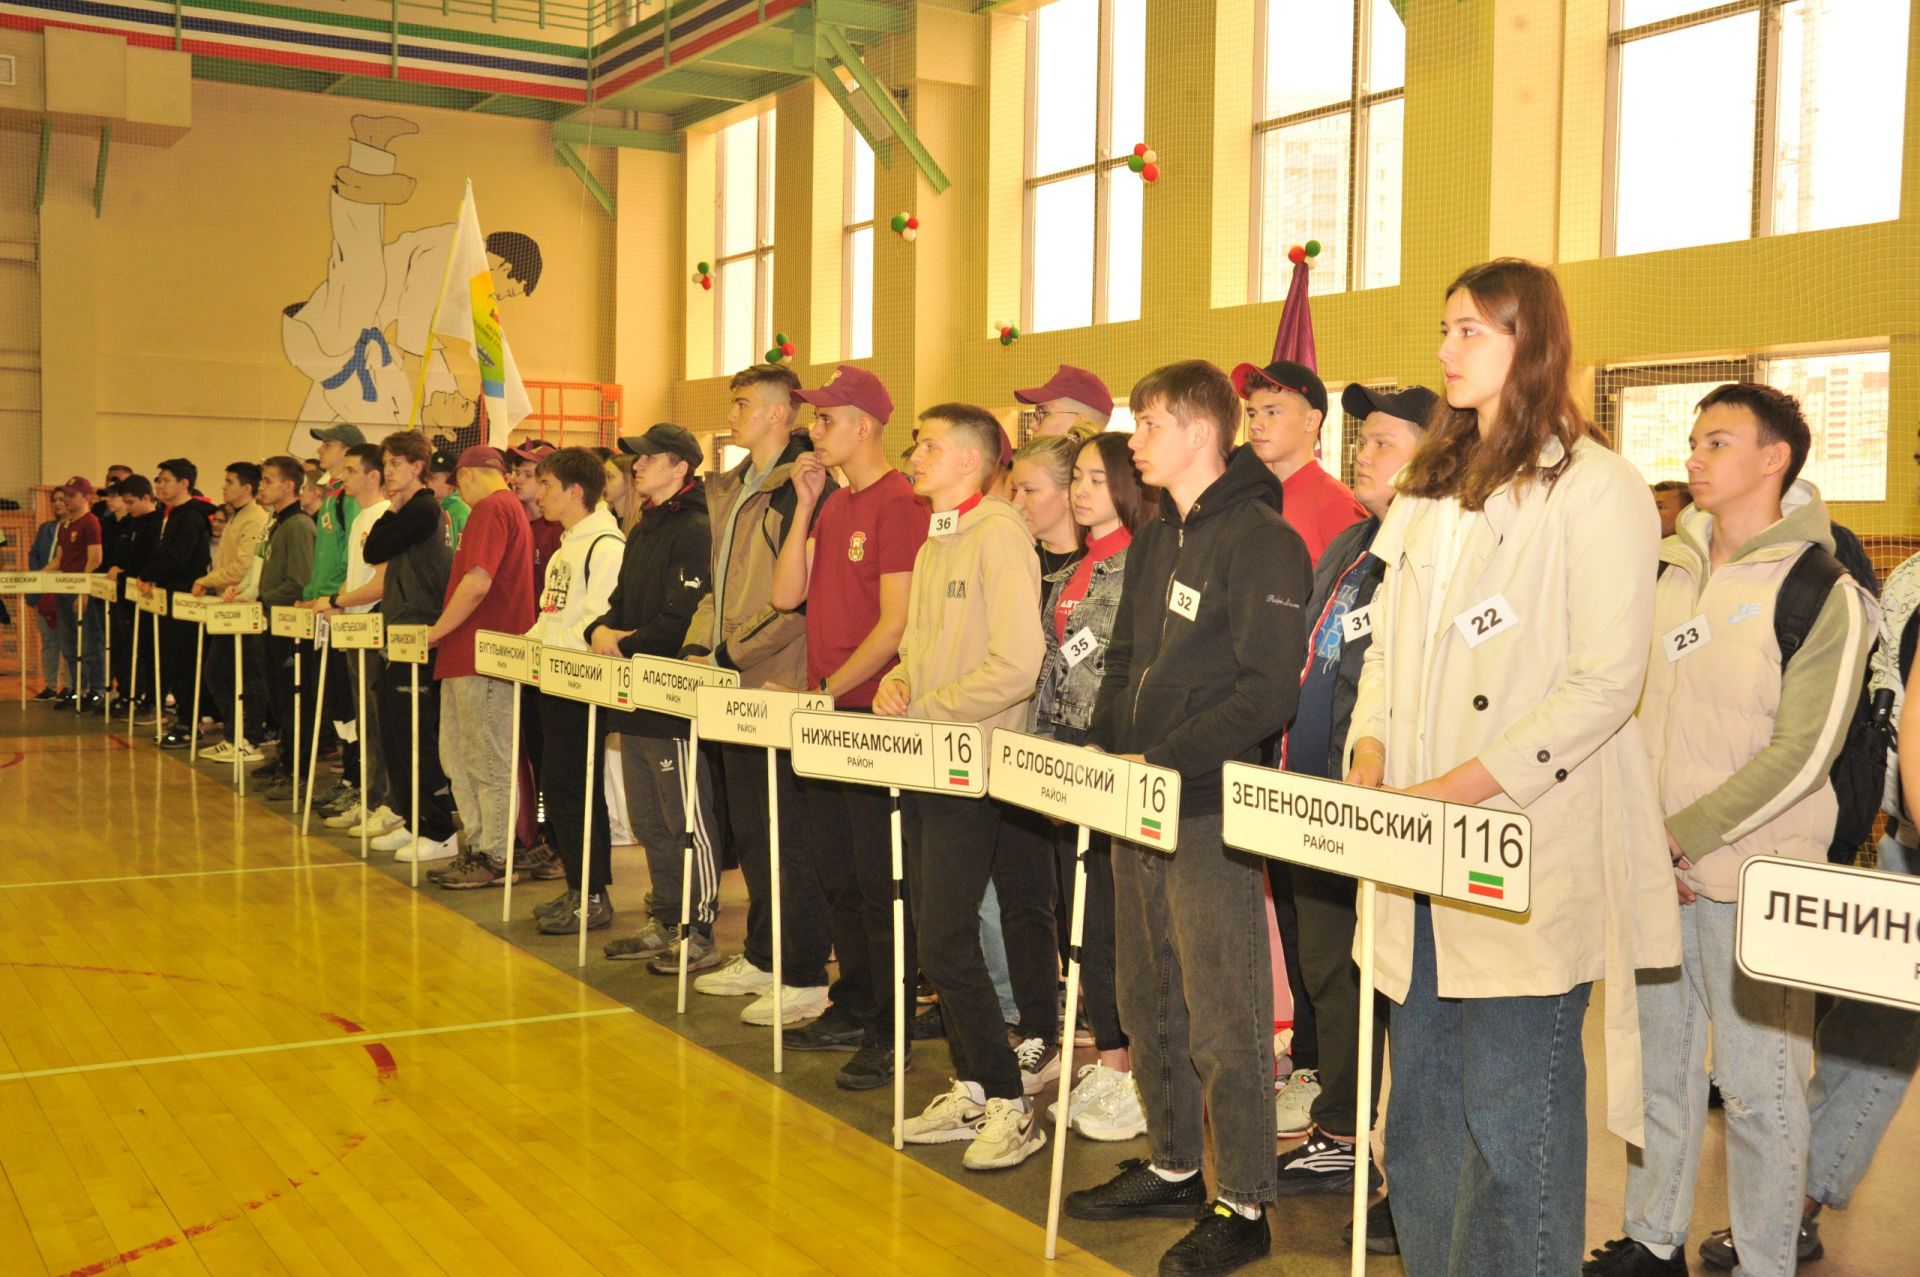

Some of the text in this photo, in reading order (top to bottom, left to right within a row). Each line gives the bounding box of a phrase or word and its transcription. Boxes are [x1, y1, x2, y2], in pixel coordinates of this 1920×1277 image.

[936, 517, 951, 531] 36
[1177, 592, 1192, 611] 32
[371, 616, 379, 633] 16
[1352, 613, 1371, 631] 31
[1471, 608, 1502, 635] 22
[1070, 637, 1089, 657] 35
[1674, 627, 1699, 651] 23
[479, 641, 526, 660] БУГУЛЬМИНСКИЙ
[531, 646, 540, 666] 16
[549, 658, 602, 682] ТЕТЮШСКИЙ
[617, 665, 630, 689] 16
[567, 680, 582, 690] РАЙОН
[666, 692, 681, 704] РАЙОН
[725, 700, 768, 720] АРСКИЙ
[737, 723, 757, 734] РАЙОН
[801, 727, 923, 756] НИЖНЕКАМСКИЙ
[944, 731, 972, 764] 16
[847, 756, 874, 769] РАЙОН
[1002, 745, 1115, 794] Р. СЛОБОДСКИЙ
[1041, 786, 1067, 804] РАЙОН
[1139, 773, 1166, 813] 16
[1232, 781, 1433, 845] ЗЕЛЕНОДОЛЬСКИЙ
[1303, 833, 1344, 855] РАЙОН
[1452, 814, 1524, 869] 116
[1764, 890, 1920, 946] ЛЕНИН
